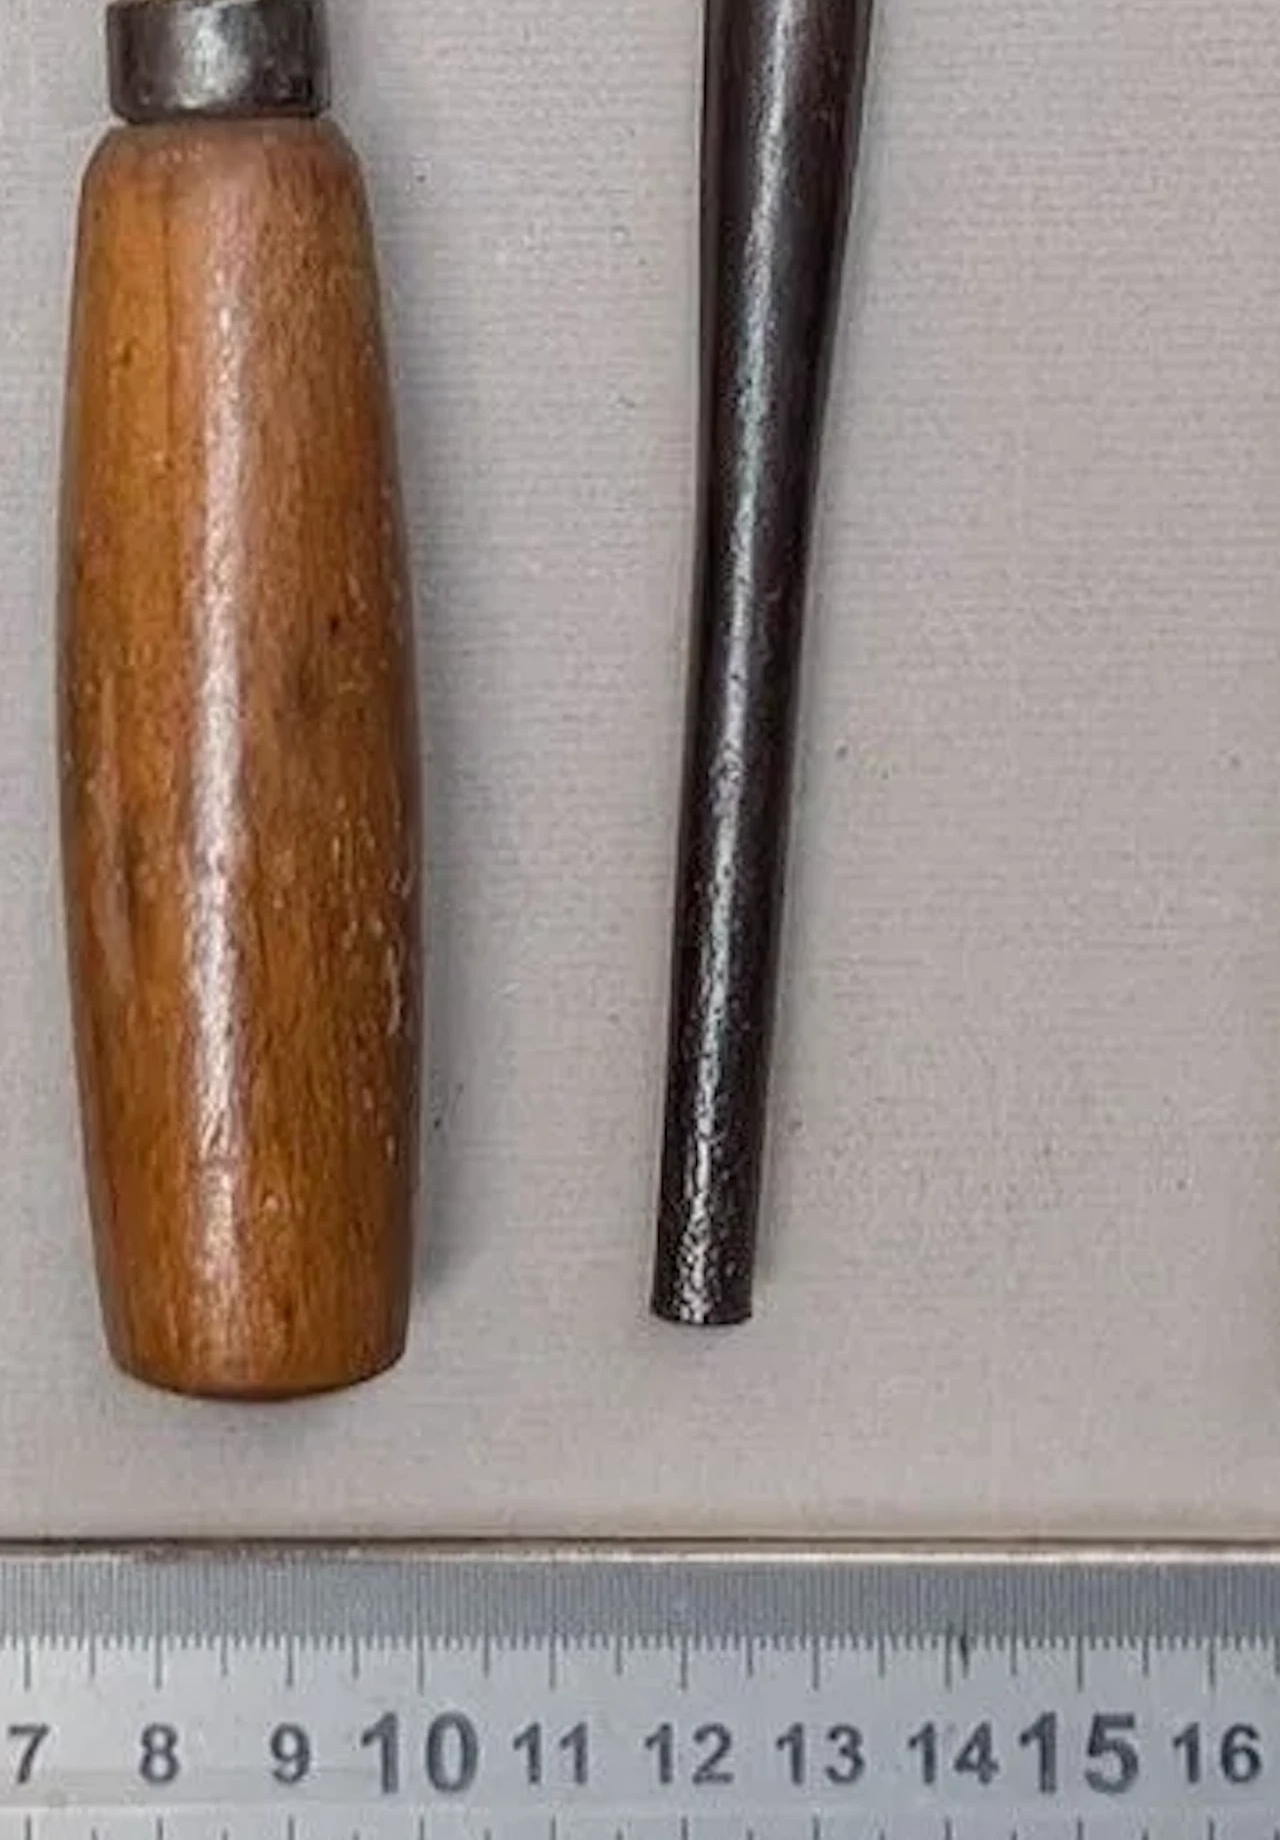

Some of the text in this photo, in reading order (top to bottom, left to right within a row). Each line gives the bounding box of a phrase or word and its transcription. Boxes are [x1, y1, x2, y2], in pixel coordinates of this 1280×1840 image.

[8, 1723, 50, 1785] 7
[139, 1723, 180, 1785] 8
[270, 1723, 311, 1787] 9
[361, 1712, 479, 1795] 10
[513, 1722, 587, 1785] 11
[645, 1723, 733, 1785] 12
[776, 1723, 865, 1785] 13
[908, 1722, 999, 1785] 14
[1019, 1712, 1138, 1794] 15
[1172, 1722, 1262, 1784] 16
